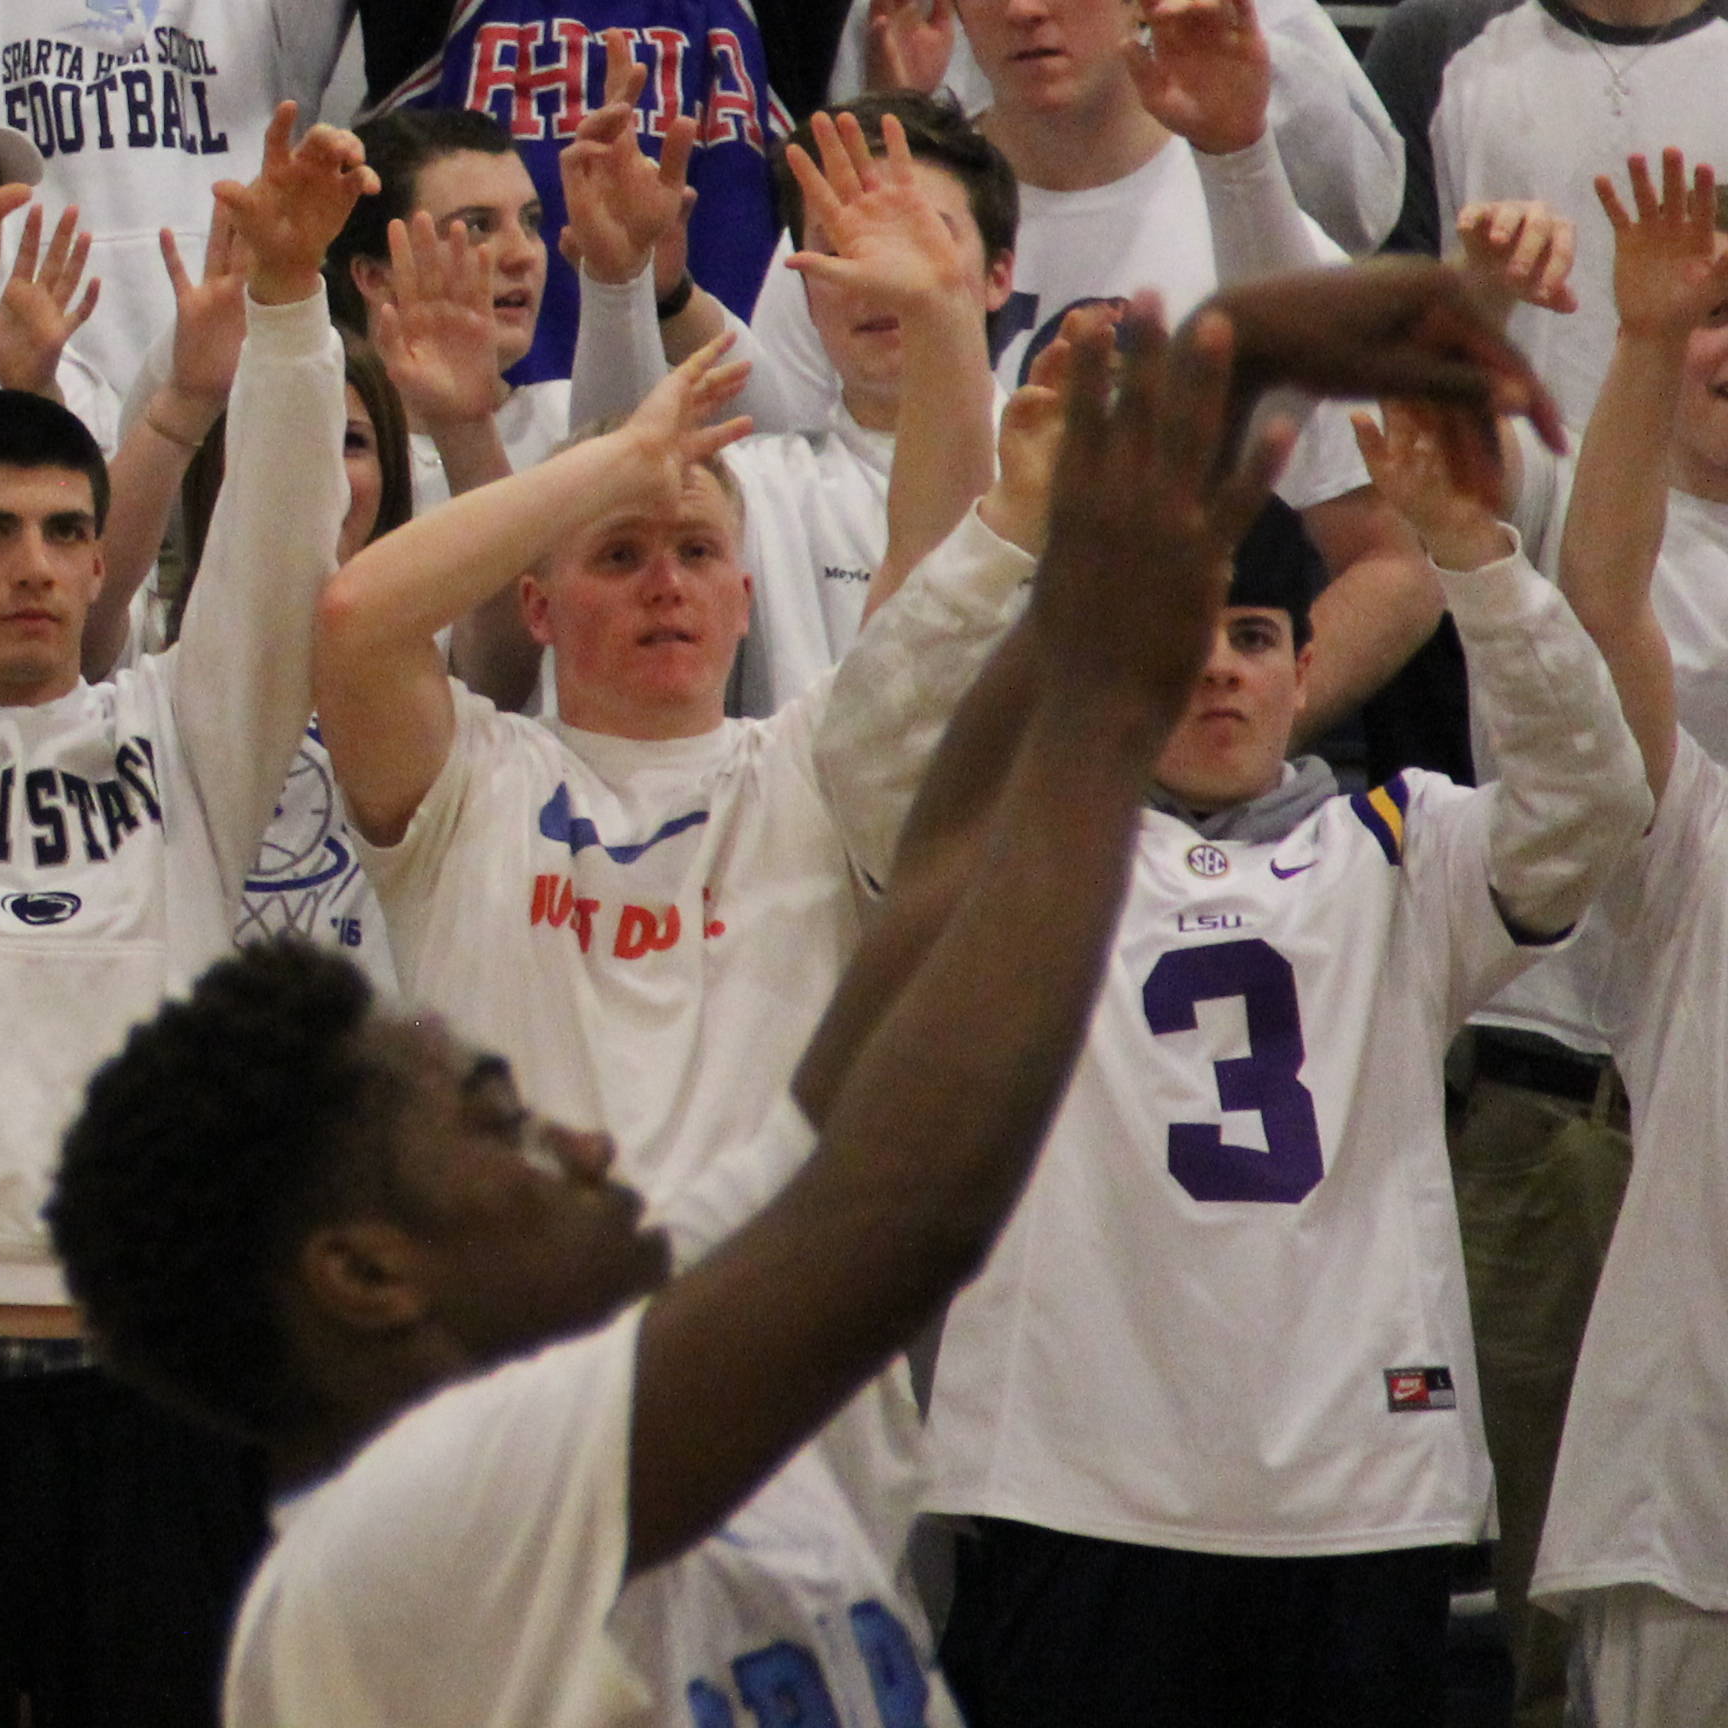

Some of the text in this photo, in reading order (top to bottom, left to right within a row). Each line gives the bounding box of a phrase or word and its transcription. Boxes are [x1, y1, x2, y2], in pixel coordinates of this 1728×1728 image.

[2, 38, 84, 85] SPARTA
[1177, 912, 1242, 933] LSU
[1142, 937, 1326, 1205] 3
